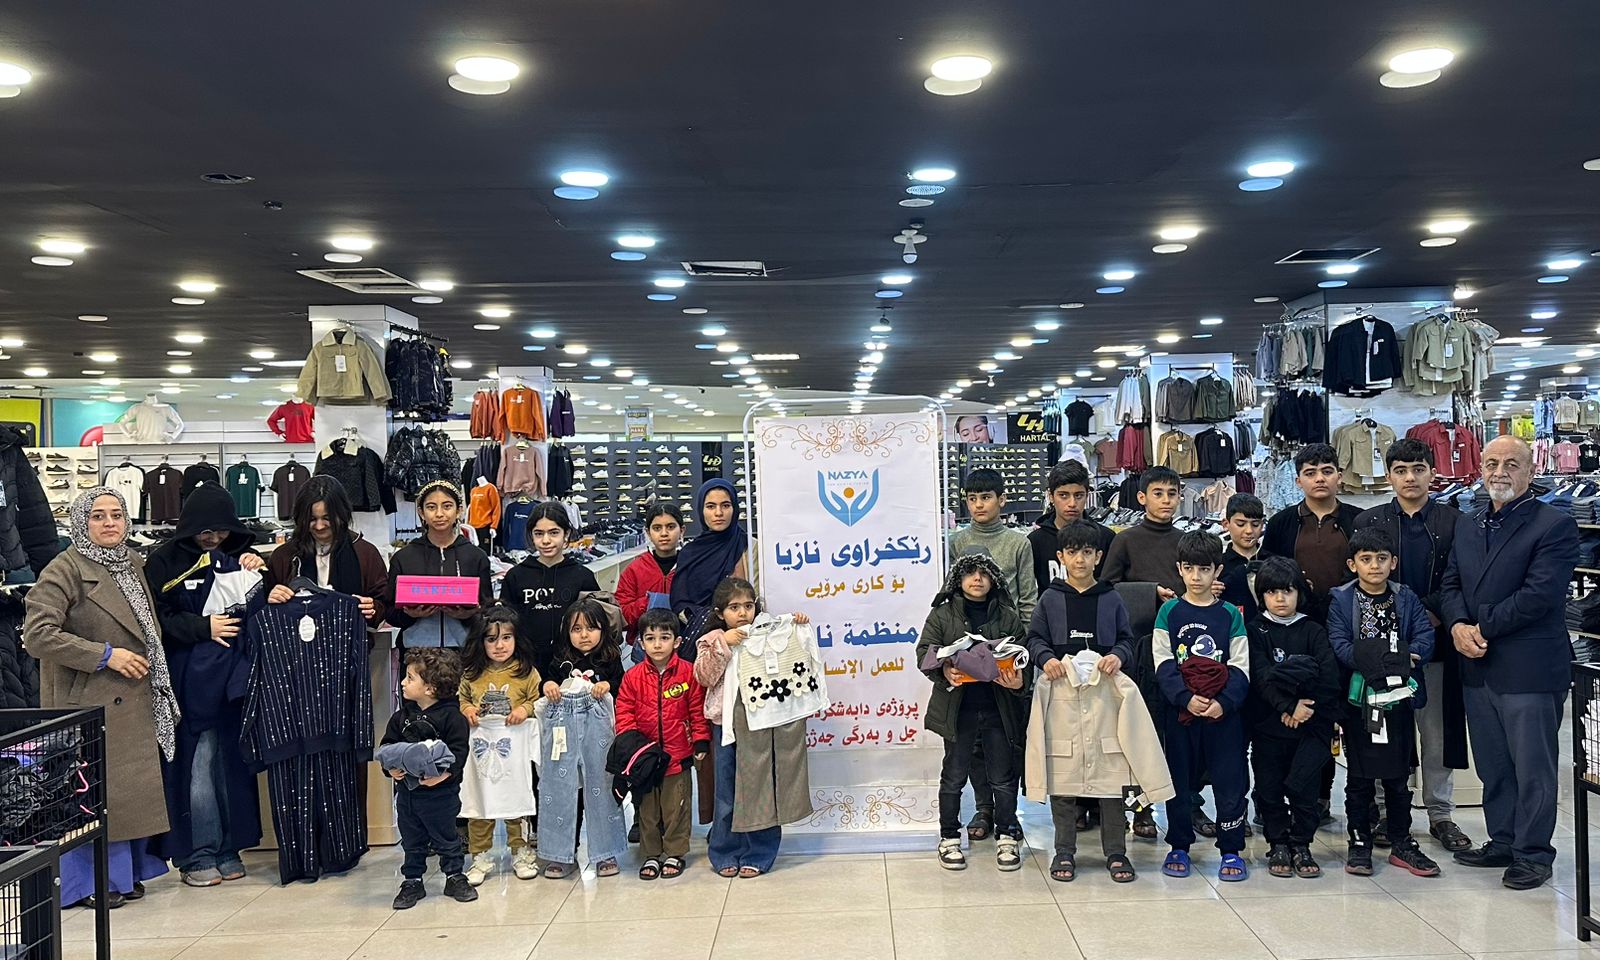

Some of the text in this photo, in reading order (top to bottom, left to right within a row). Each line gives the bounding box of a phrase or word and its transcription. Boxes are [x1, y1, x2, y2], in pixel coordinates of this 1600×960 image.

[1020, 434, 1051, 442] HARTAL
[828, 470, 868, 480] NAZYA
[891, 574, 905, 593] بۆ
[843, 622, 919, 647] منظمة
[870, 657, 905, 677] للعمل
[842, 725, 880, 746] بەرگی
[885, 730, 893, 743] و
[899, 725, 917, 742] جل
